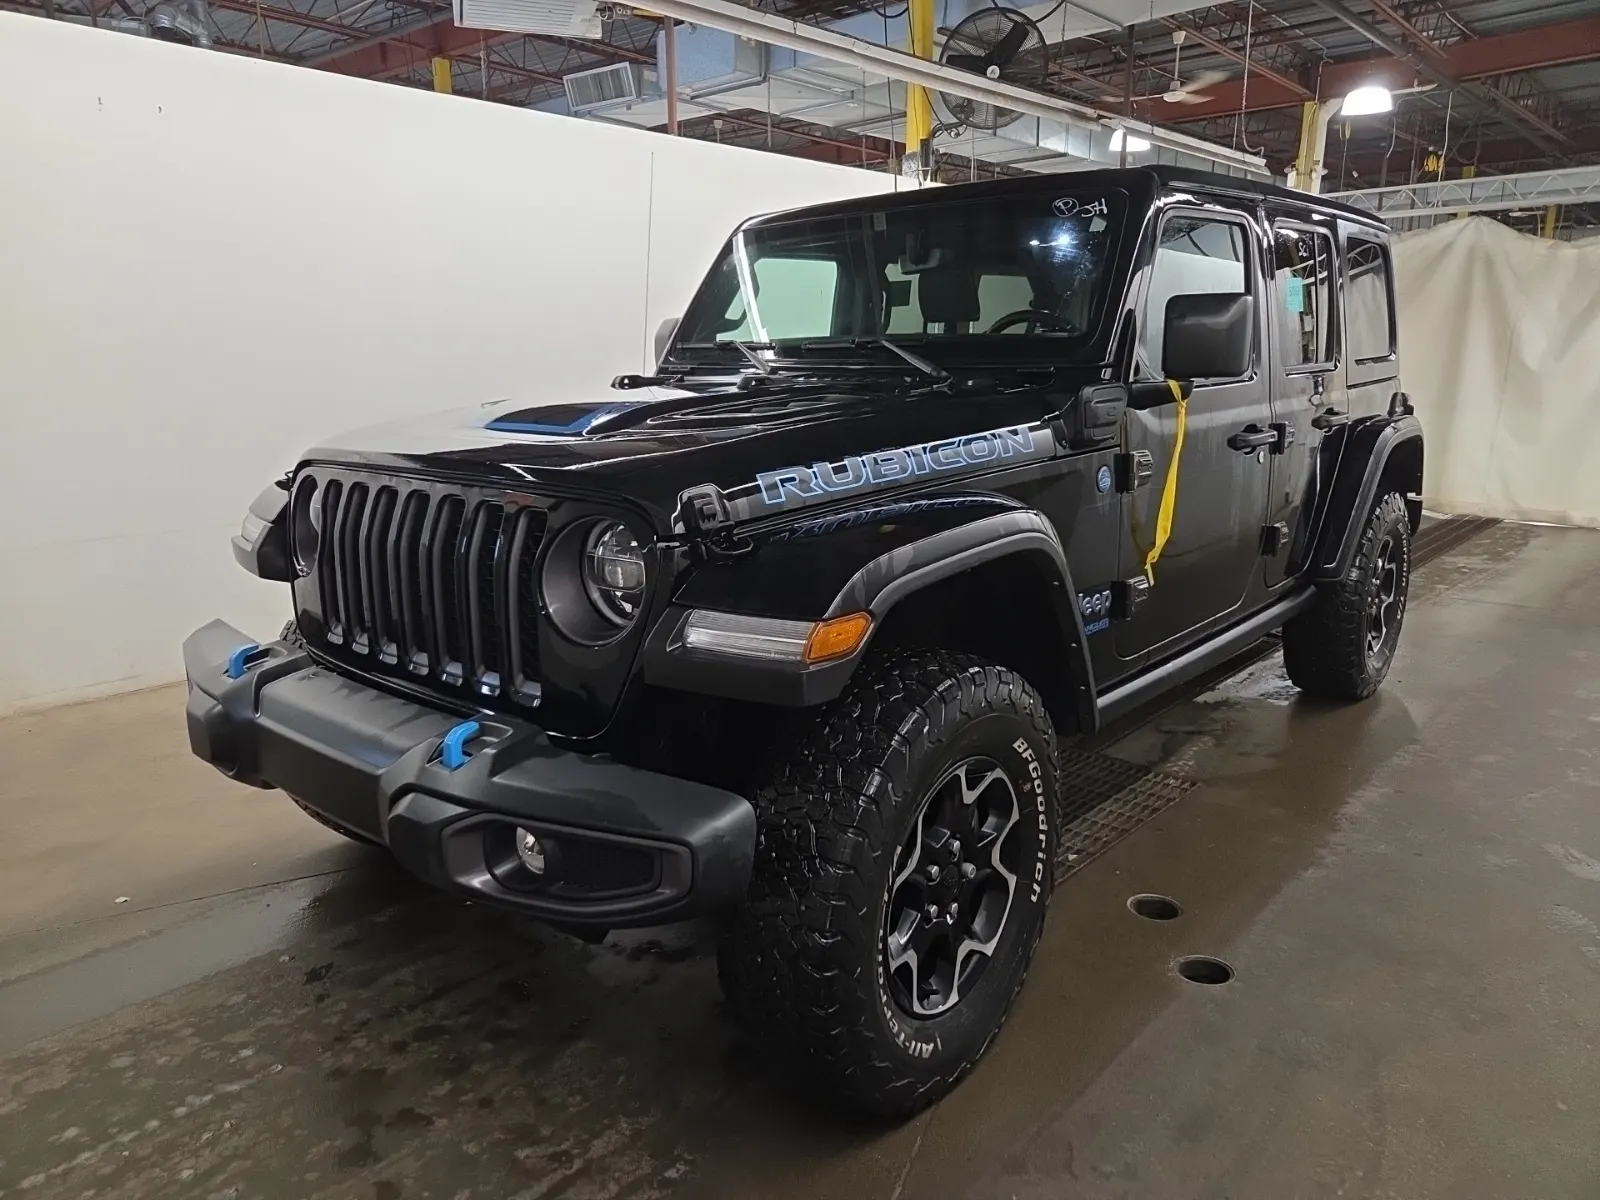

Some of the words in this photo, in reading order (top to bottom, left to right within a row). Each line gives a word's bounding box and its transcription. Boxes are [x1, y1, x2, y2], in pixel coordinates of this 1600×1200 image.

[755, 425, 1035, 505] RUBICON
[1077, 590, 1112, 616] Jeep
[1012, 736, 1049, 903] BFGoodrich
